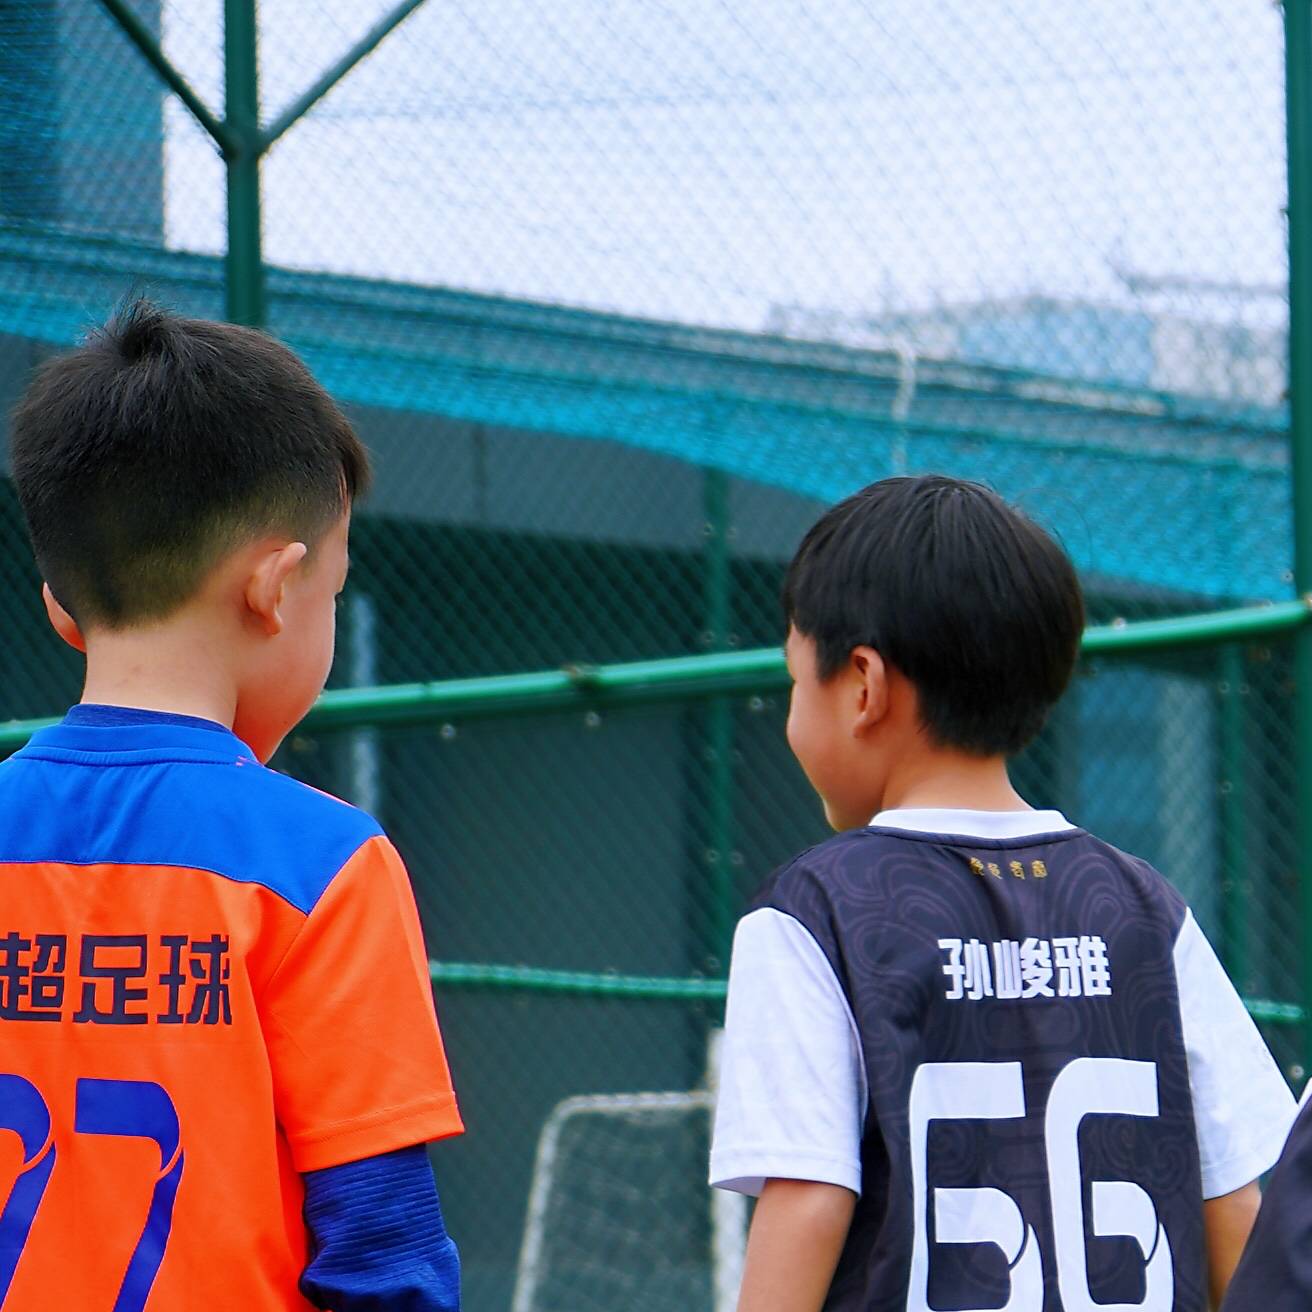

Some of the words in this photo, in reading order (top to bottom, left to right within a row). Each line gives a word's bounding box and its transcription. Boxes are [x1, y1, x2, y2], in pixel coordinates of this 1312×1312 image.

[0, 931, 233, 1025] 超足球
[937, 935, 1112, 1001] 孙峻雅
